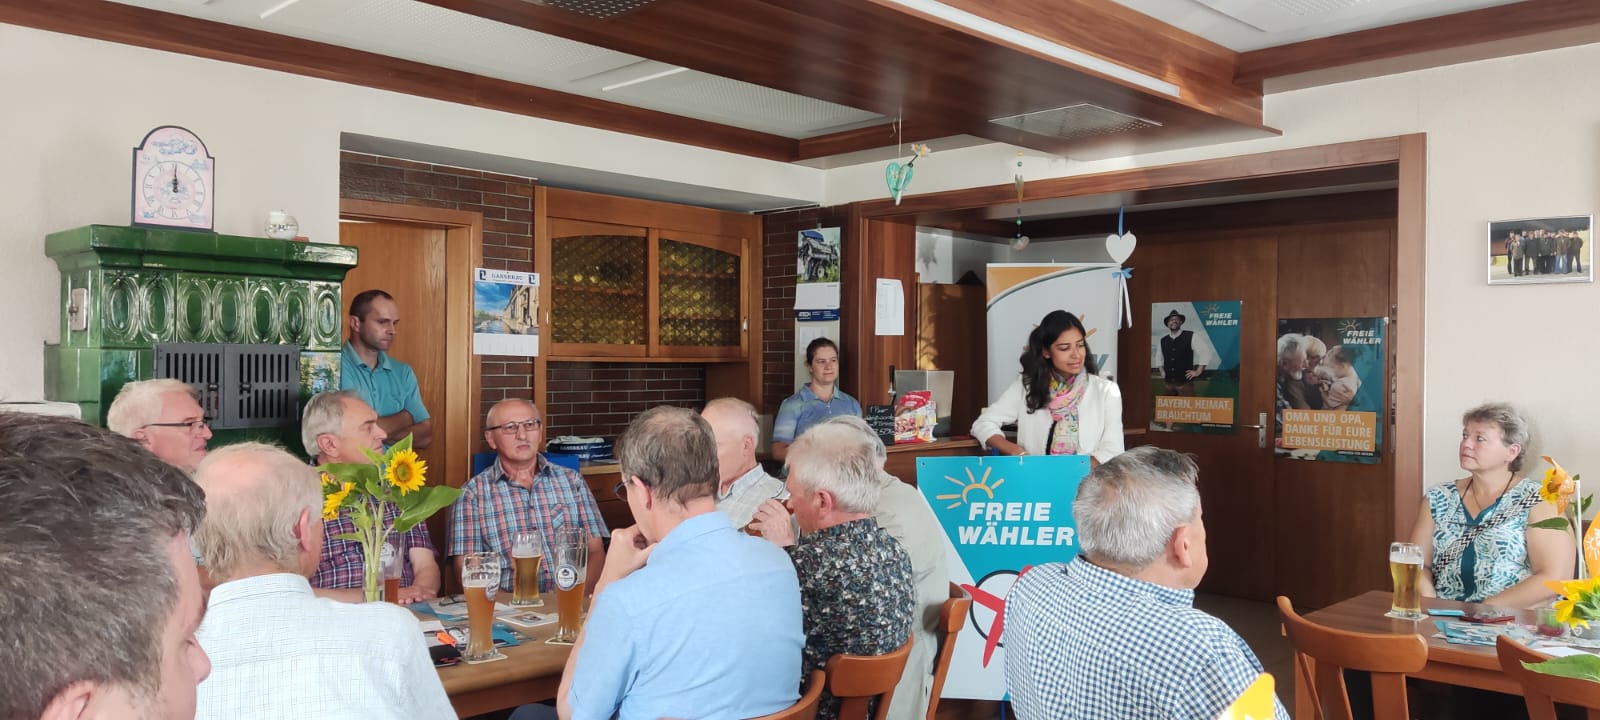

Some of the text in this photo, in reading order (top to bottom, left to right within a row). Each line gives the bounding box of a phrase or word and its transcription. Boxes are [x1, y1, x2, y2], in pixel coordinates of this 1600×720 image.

[1343, 337, 1382, 345] WÄHLER
[1157, 398, 1193, 409] BAYERN,
[1157, 410, 1212, 421] BRAUCHTUM
[1286, 411, 1365, 426] OMA UND OPA,
[1285, 423, 1372, 437] DANKE FÜR EURE
[1284, 435, 1370, 450] LEBENSLEISTUNG
[968, 502, 1052, 521] FREIE
[958, 522, 1075, 546] WÄHLER
